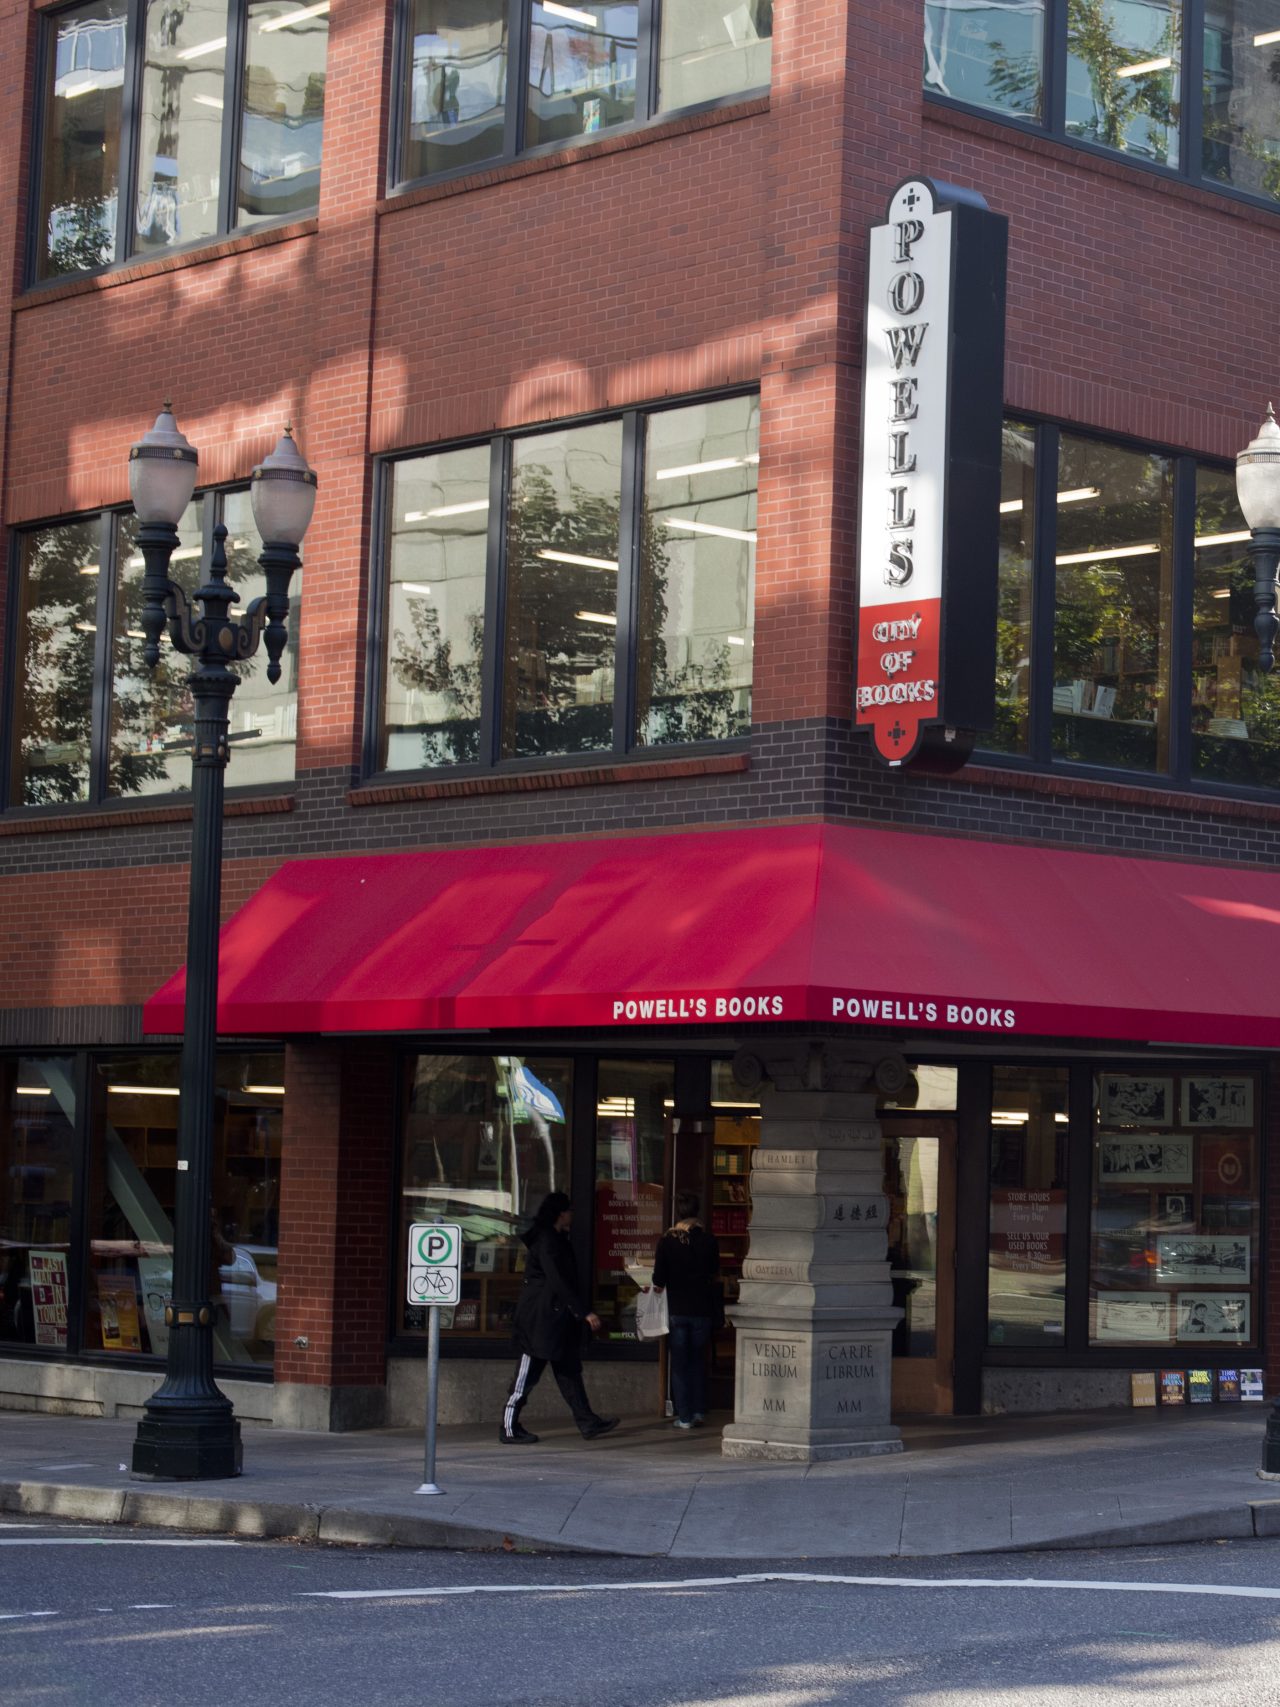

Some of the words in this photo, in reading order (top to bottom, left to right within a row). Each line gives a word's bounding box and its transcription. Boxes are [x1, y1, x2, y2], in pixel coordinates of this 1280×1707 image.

[873, 612, 921, 643] CITY
[880, 651, 914, 673] OF
[856, 680, 935, 709] BOOKS
[613, 998, 707, 1020] POWELL'S
[715, 996, 784, 1017] BOOKS
[832, 997, 938, 1022] POWELL'S
[946, 1004, 1016, 1028] BOOKS
[767, 1154, 806, 1165] HAMLET
[1007, 1192, 1027, 1202] STORE
[1028, 1192, 1051, 1202] HOURS
[1012, 1212, 1030, 1224] Every
[1031, 1212, 1044, 1224] Day
[1006, 1231, 1021, 1241] SELL
[1022, 1231, 1031, 1241] US
[1032, 1231, 1050, 1241] YOUR
[428, 1236, 445, 1257] P
[1008, 1241, 1025, 1250] USED
[1026, 1241, 1048, 1250] BOOKS
[42, 1257, 64, 1271] LAST
[33, 1271, 51, 1284] MAN
[37, 1305, 67, 1323] TOWER
[754, 1343, 797, 1359] VENDE
[828, 1344, 873, 1360] CARPE
[752, 1362, 798, 1379] LIBRUM
[826, 1365, 874, 1380] LIBRUM
[763, 1398, 786, 1413] MM
[837, 1400, 863, 1414] MM
